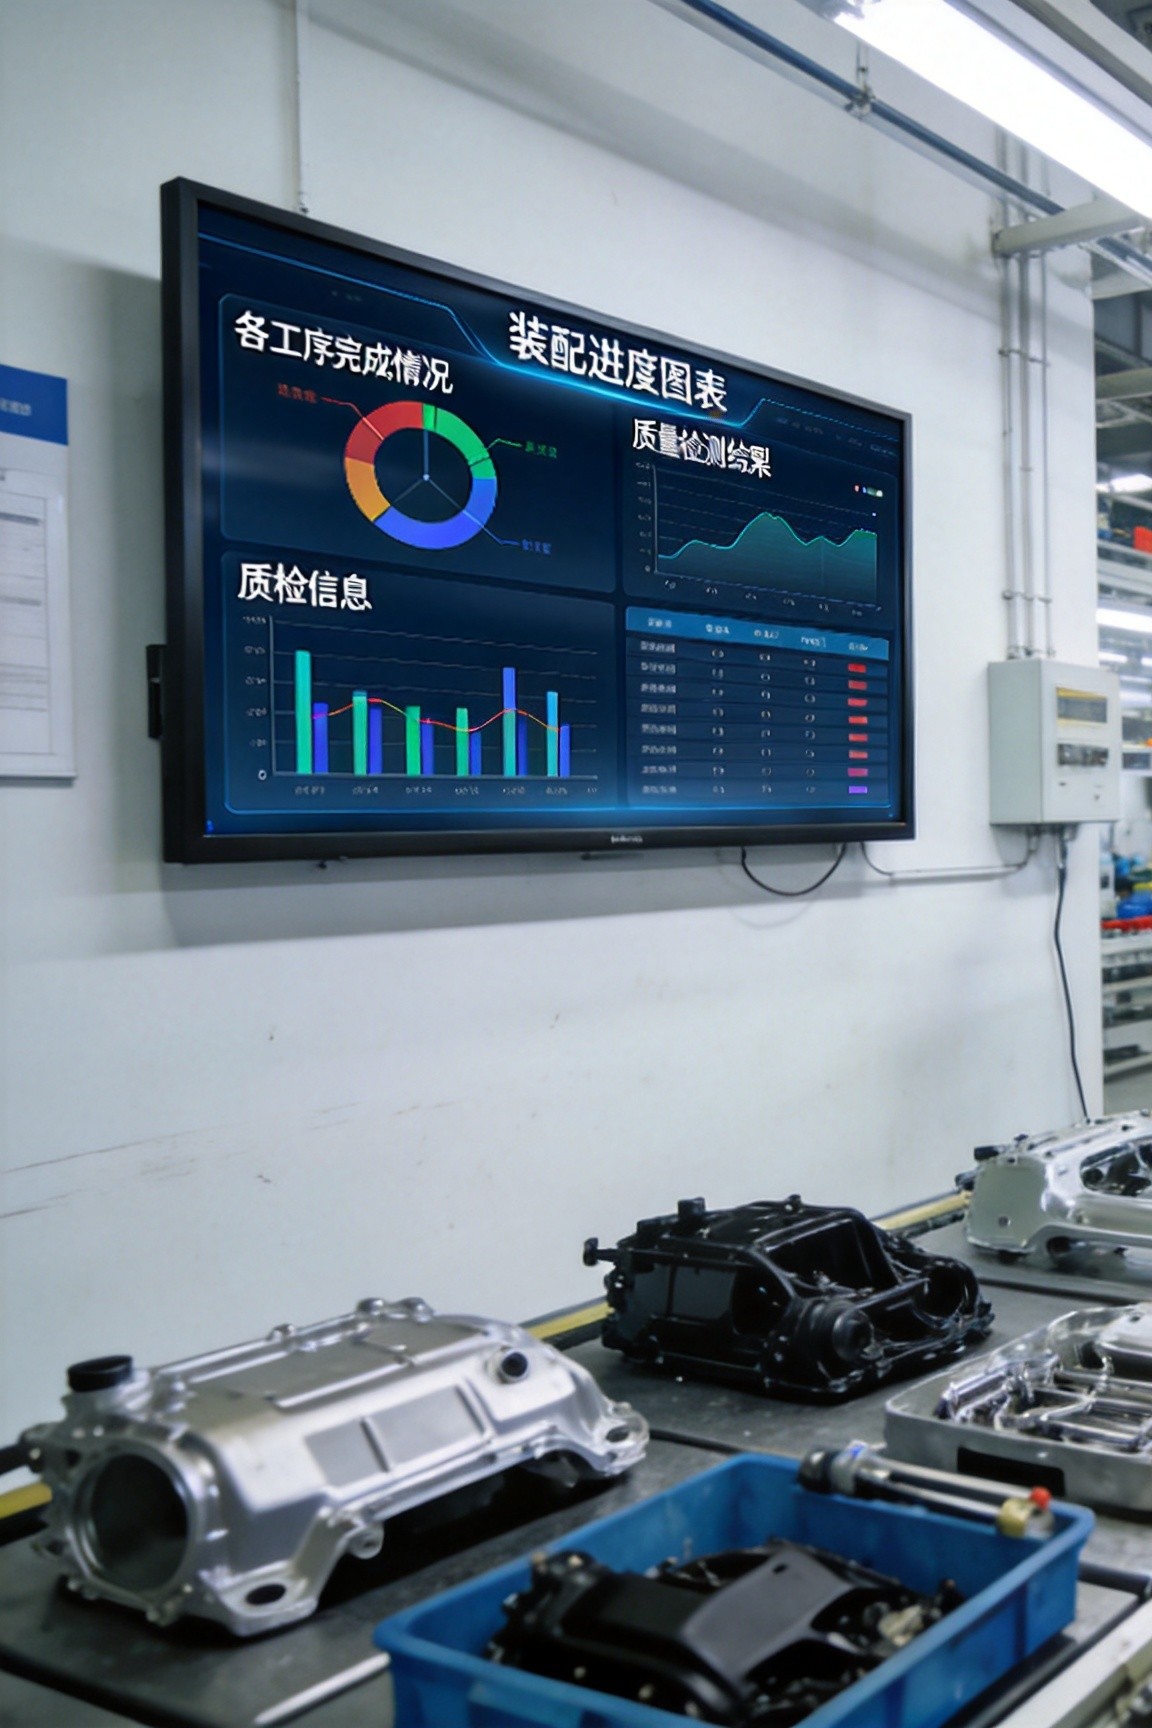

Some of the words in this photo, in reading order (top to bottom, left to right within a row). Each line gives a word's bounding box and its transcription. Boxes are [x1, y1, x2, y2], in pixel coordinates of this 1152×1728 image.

[234, 310, 454, 394] 各工序完成情况
[508, 311, 728, 413] 装配进度图表
[237, 562, 373, 611] 质检信息
